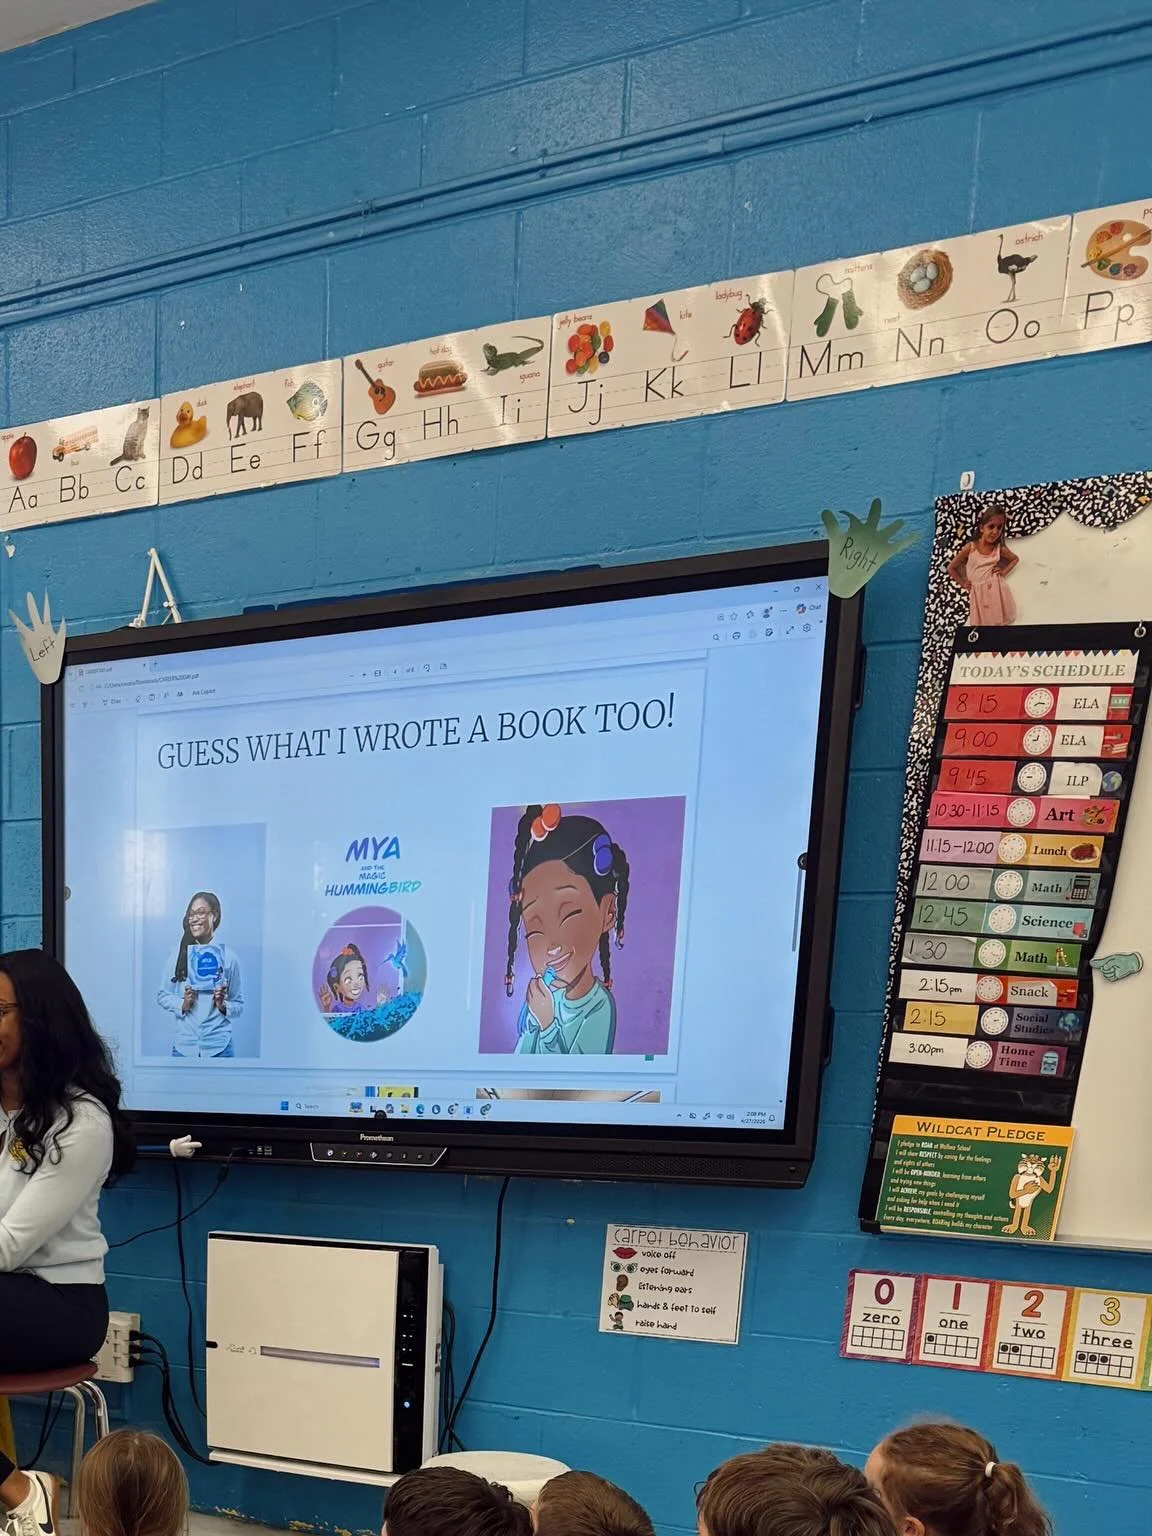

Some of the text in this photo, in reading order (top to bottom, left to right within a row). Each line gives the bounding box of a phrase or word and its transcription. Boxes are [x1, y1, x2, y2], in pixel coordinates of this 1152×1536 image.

[1015, 232, 1043, 245] ostrich
[716, 290, 742, 302] ladybug
[558, 314, 592, 330] jelly beans
[680, 311, 692, 319] kite
[986, 308, 1040, 343] Oo
[896, 324, 945, 361] Nn
[377, 360, 395, 372] guitar
[800, 340, 864, 378] Mm
[520, 371, 540, 383] iguana
[645, 366, 683, 403] Kk
[568, 379, 603, 425] Jj
[424, 405, 459, 440] Hh
[293, 430, 326, 462] Ff
[356, 421, 395, 460] Gg
[231, 443, 260, 473] Ee
[173, 452, 202, 483] Dd
[115, 466, 145, 492] Cc
[60, 474, 88, 503] Bb
[9, 486, 38, 512] Aa
[840, 537, 878, 572] Right
[30, 636, 55, 661] Left
[1032, 665, 1126, 676] SCHEDULE
[1073, 699, 1099, 709] ELA
[158, 692, 674, 769] GUESS WHAT I WROTE A BOOK TOO!
[1060, 735, 1087, 745] ELA
[1066, 776, 1089, 786] ILP
[1045, 808, 1075, 821] Art
[346, 836, 400, 862] MYA
[1034, 846, 1067, 856] Lunch
[359, 872, 386, 880] MAGIC
[325, 880, 421, 896] HUMMINGBIRD
[1032, 883, 1062, 893] Math
[1022, 915, 1073, 929] Science
[1015, 952, 1048, 964] Math
[1010, 986, 1048, 997] Snack
[1016, 1012, 1049, 1023] Social
[1000, 1045, 1035, 1057] Home
[998, 1057, 1028, 1068] Time
[360, 1133, 393, 1141] Promethean
[917, 1121, 1046, 1141] WILDCAT PLEDGE
[664, 1251, 677, 1259] off
[640, 1266, 694, 1277] eyes forward
[638, 1282, 693, 1294] listening ears
[637, 1300, 717, 1315] hands & feet to self
[1021, 1290, 1044, 1318] 2
[1099, 1297, 1121, 1326] 3
[635, 1320, 678, 1331] raise hand
[862, 1312, 1133, 1349] zero one two three
